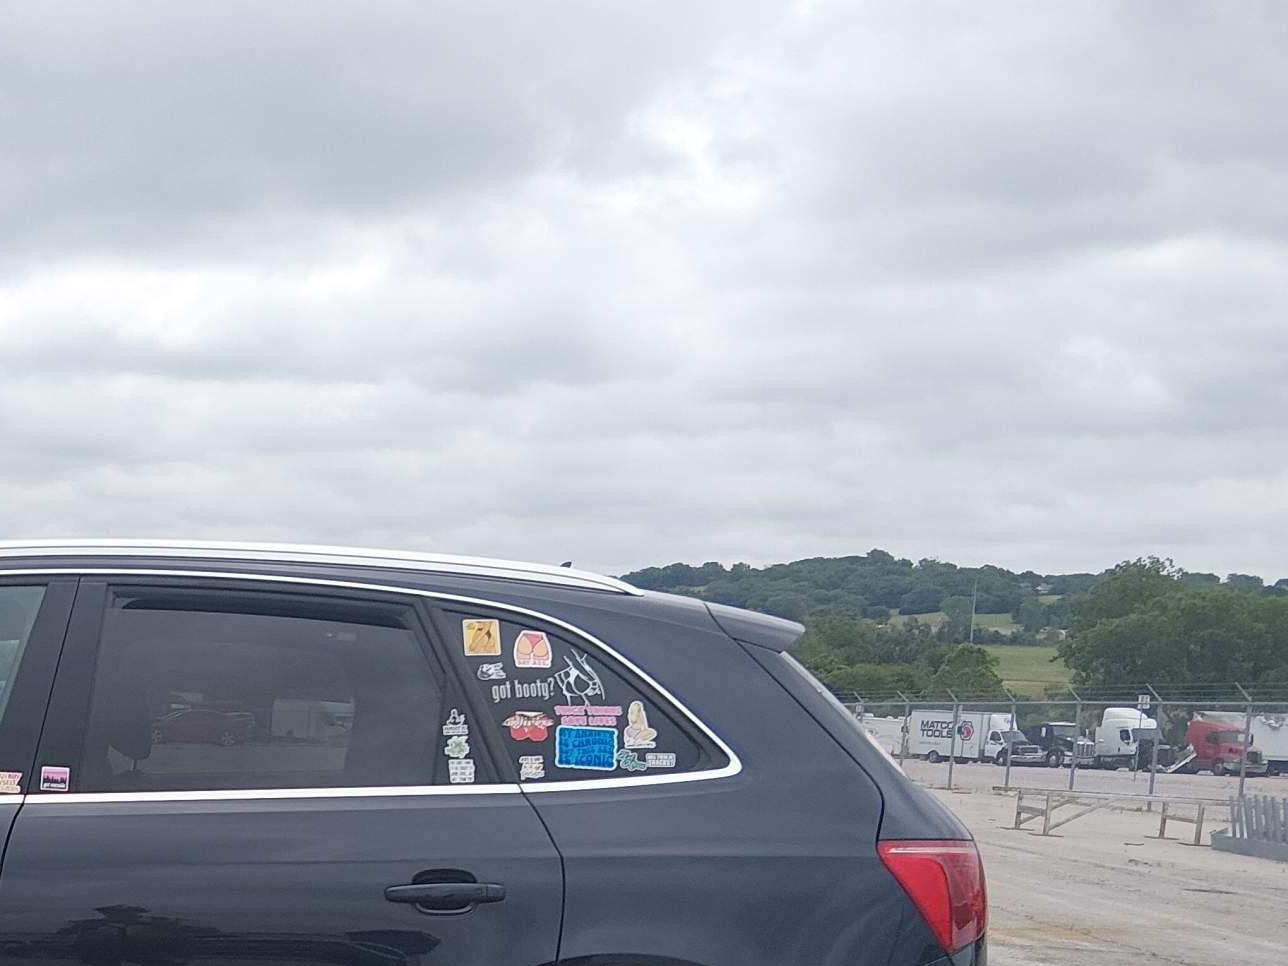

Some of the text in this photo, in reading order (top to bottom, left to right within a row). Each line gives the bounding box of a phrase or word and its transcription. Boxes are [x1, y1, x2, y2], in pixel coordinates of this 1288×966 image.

[491, 677, 555, 704] got booty?
[920, 729, 953, 739] TOOLS
